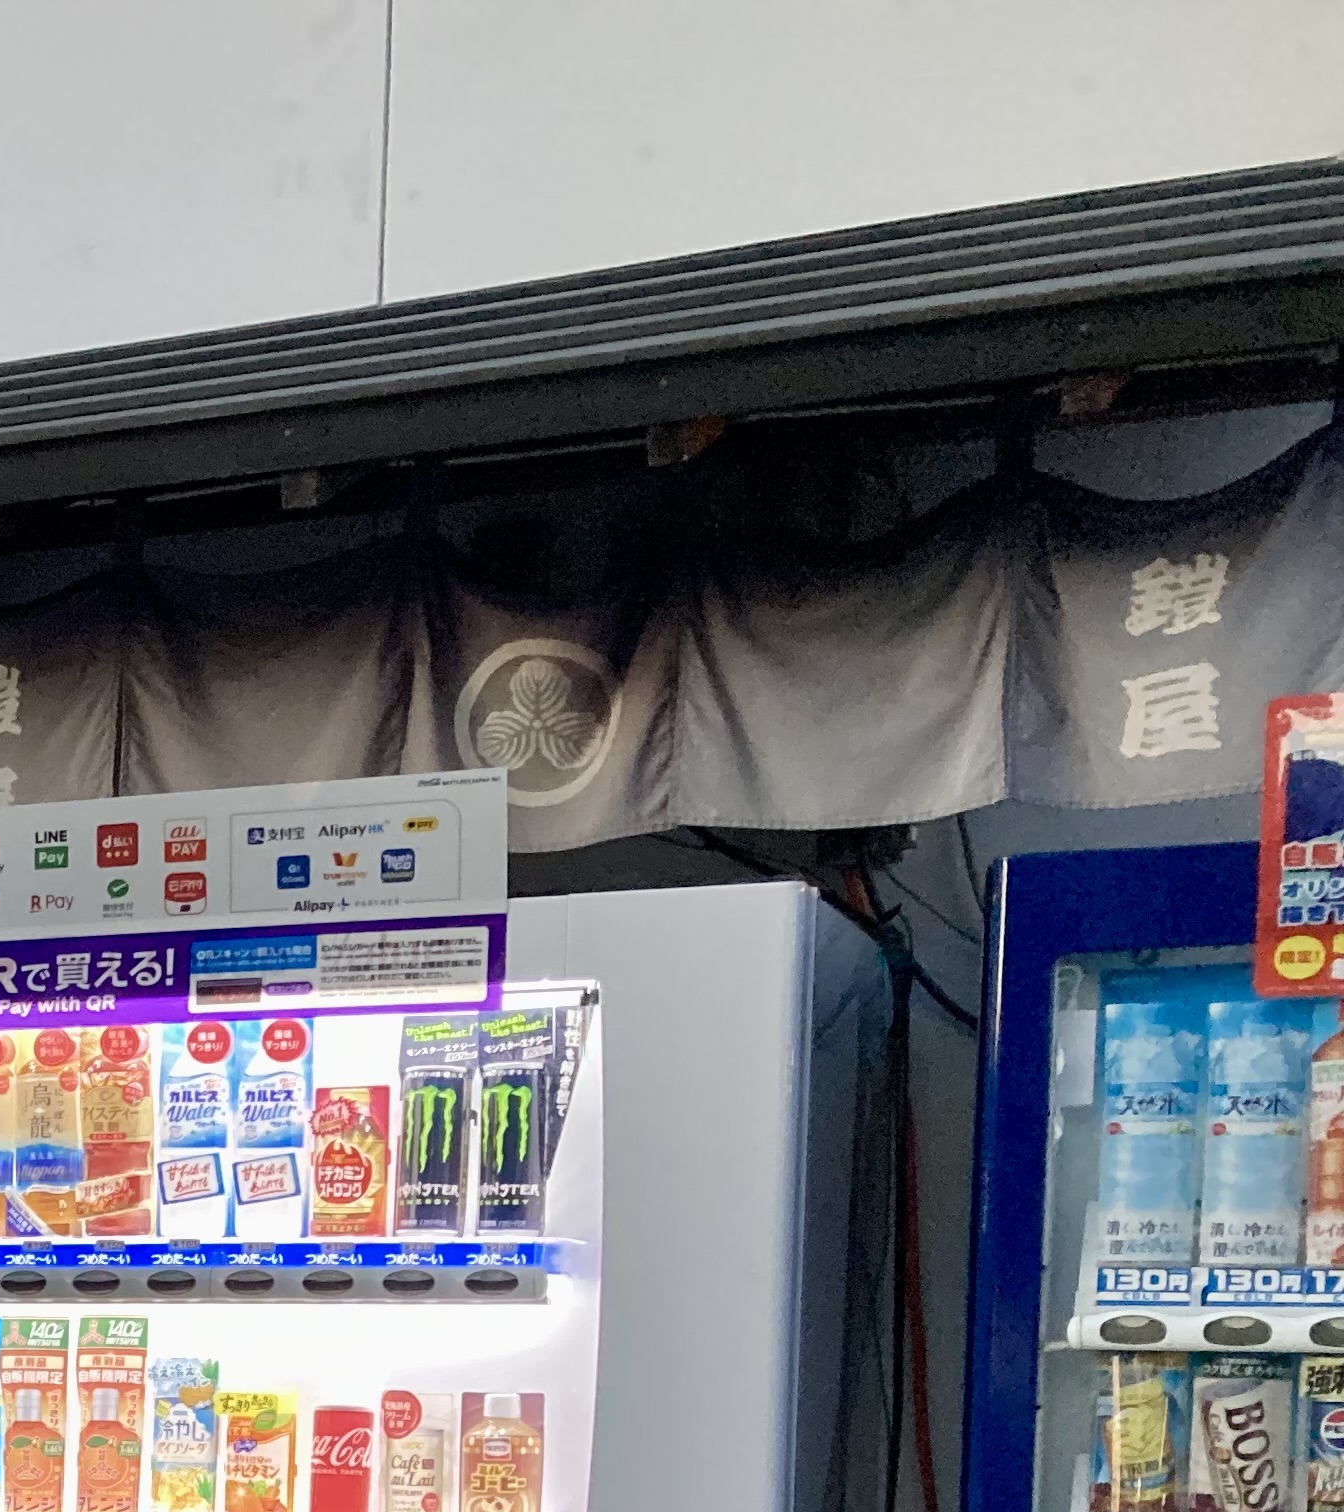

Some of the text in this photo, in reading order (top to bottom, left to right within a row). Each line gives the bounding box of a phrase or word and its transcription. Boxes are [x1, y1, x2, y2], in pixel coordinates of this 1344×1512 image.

[1120, 554, 1229, 759] 鎧屋
[35, 830, 68, 844] LINE
[170, 823, 201, 839] au
[267, 826, 305, 842] 支付宝
[171, 841, 201, 857] PAY
[39, 851, 66, 866] Pay
[46, 894, 74, 912] Pay
[294, 900, 334, 912] Alipay
[38, 996, 81, 1013] with
[86, 994, 116, 1012] QR
[405, 1021, 452, 1037] Unleash
[481, 1013, 527, 1032] Unleash
[406, 1042, 476, 1057] モンスターエナジー
[483, 1035, 552, 1054] モンスターエナジー
[169, 1089, 220, 1103] カルピス
[245, 1088, 295, 1103] カルピス
[29, 1082, 52, 1139] 烏龍
[167, 1103, 221, 1122] Water
[242, 1103, 297, 1122] Water
[1119, 1093, 1183, 1117] 天然水
[1226, 1093, 1291, 1117] 天然水
[318, 1165, 365, 1182] ドデカミン
[319, 1182, 363, 1198] ストロング
[1104, 1267, 1189, 1293] 130円
[1216, 1268, 1303, 1294] 130円
[1, 1370, 65, 1385] 自販機限定
[78, 1369, 143, 1385] 自販機限定
[161, 1418, 207, 1442] 冷やし
[391, 1453, 421, 1473] Café
[1225, 1400, 1280, 1511] BOSS
[477, 1463, 517, 1477] ミルク
[390, 1471, 436, 1488] au Lait
[470, 1474, 528, 1494] コーヒー
